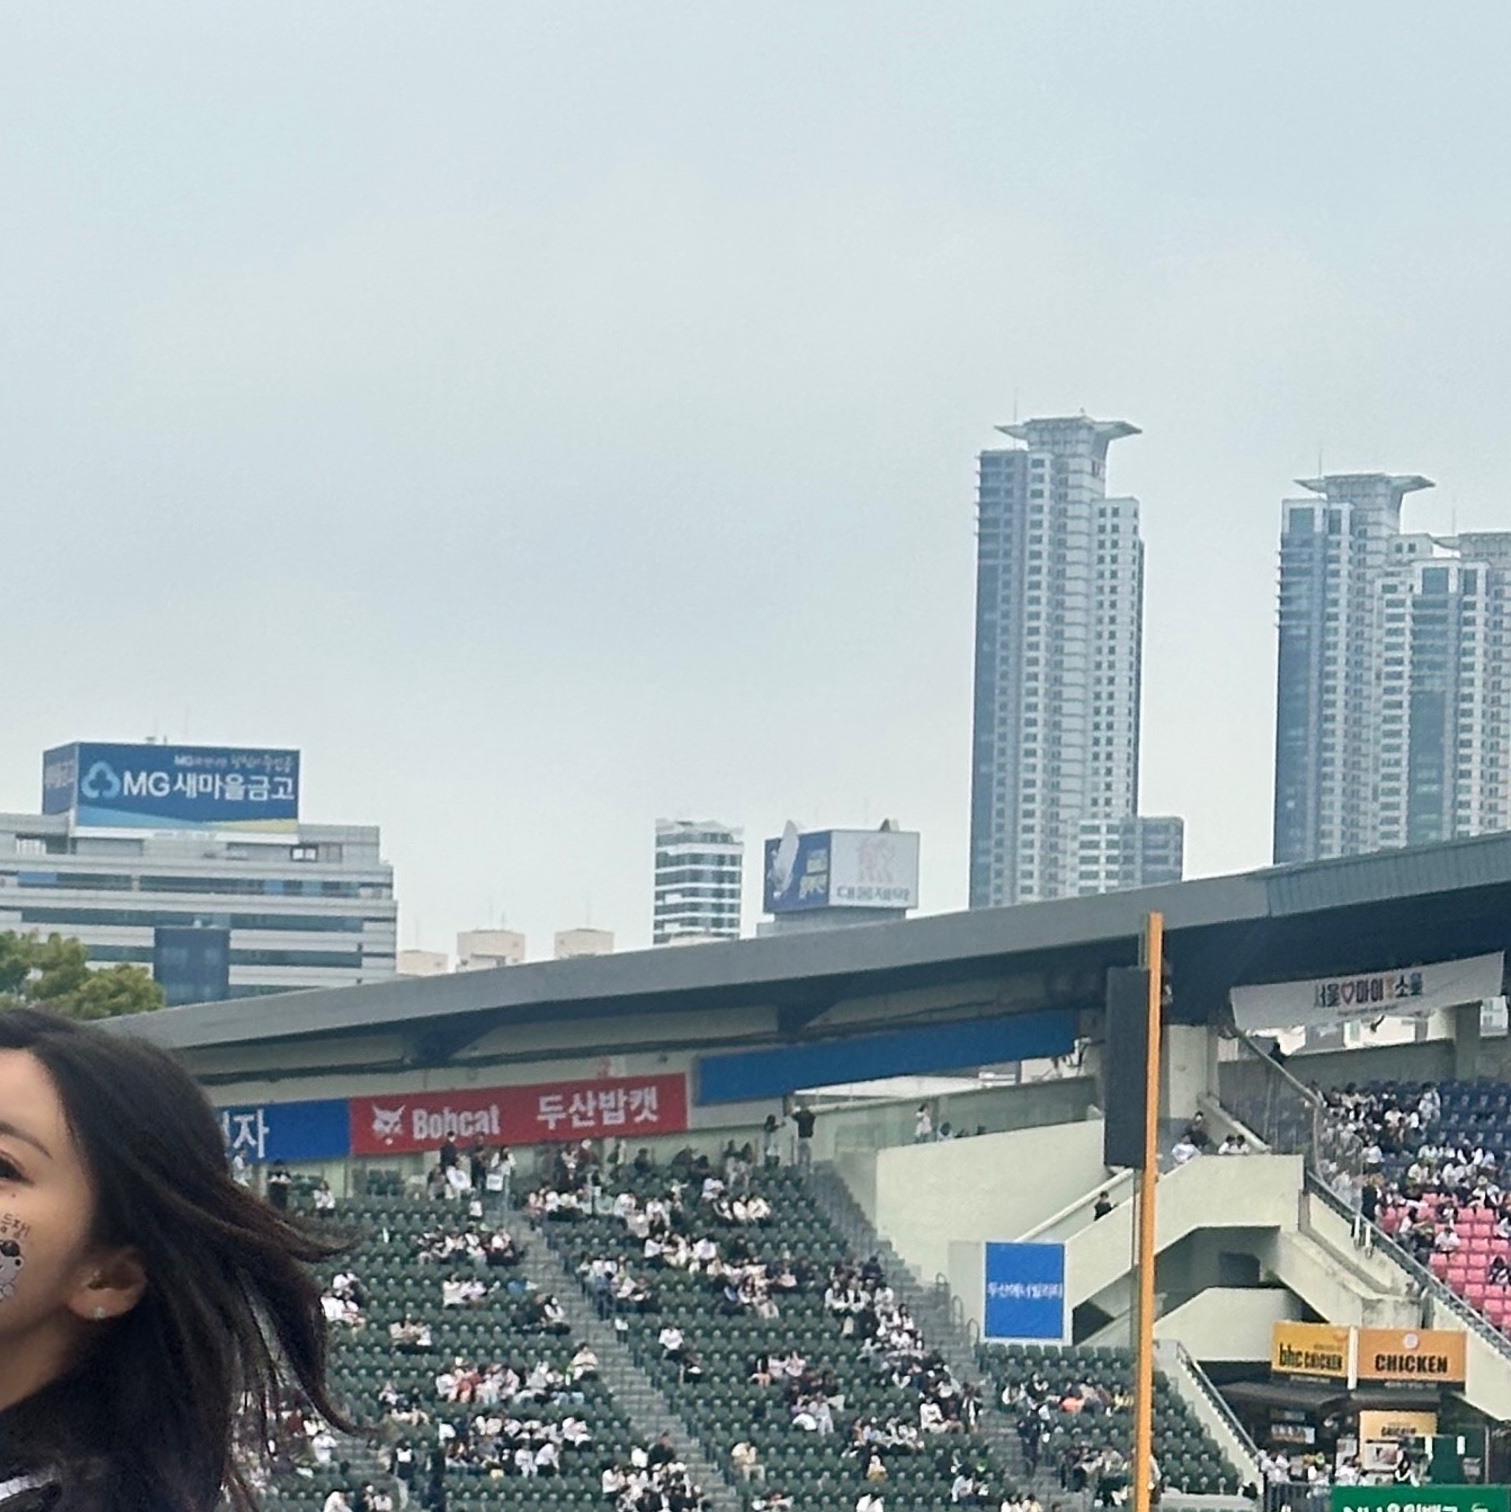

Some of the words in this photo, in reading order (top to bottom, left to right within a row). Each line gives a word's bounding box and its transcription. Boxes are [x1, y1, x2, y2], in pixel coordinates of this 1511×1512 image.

[412, 1104, 500, 1141] Bobcat
[537, 1086, 658, 1131] 두산밥캣
[223, 1108, 269, 1158] 자
[1375, 1353, 1448, 1374] CHICKEN
